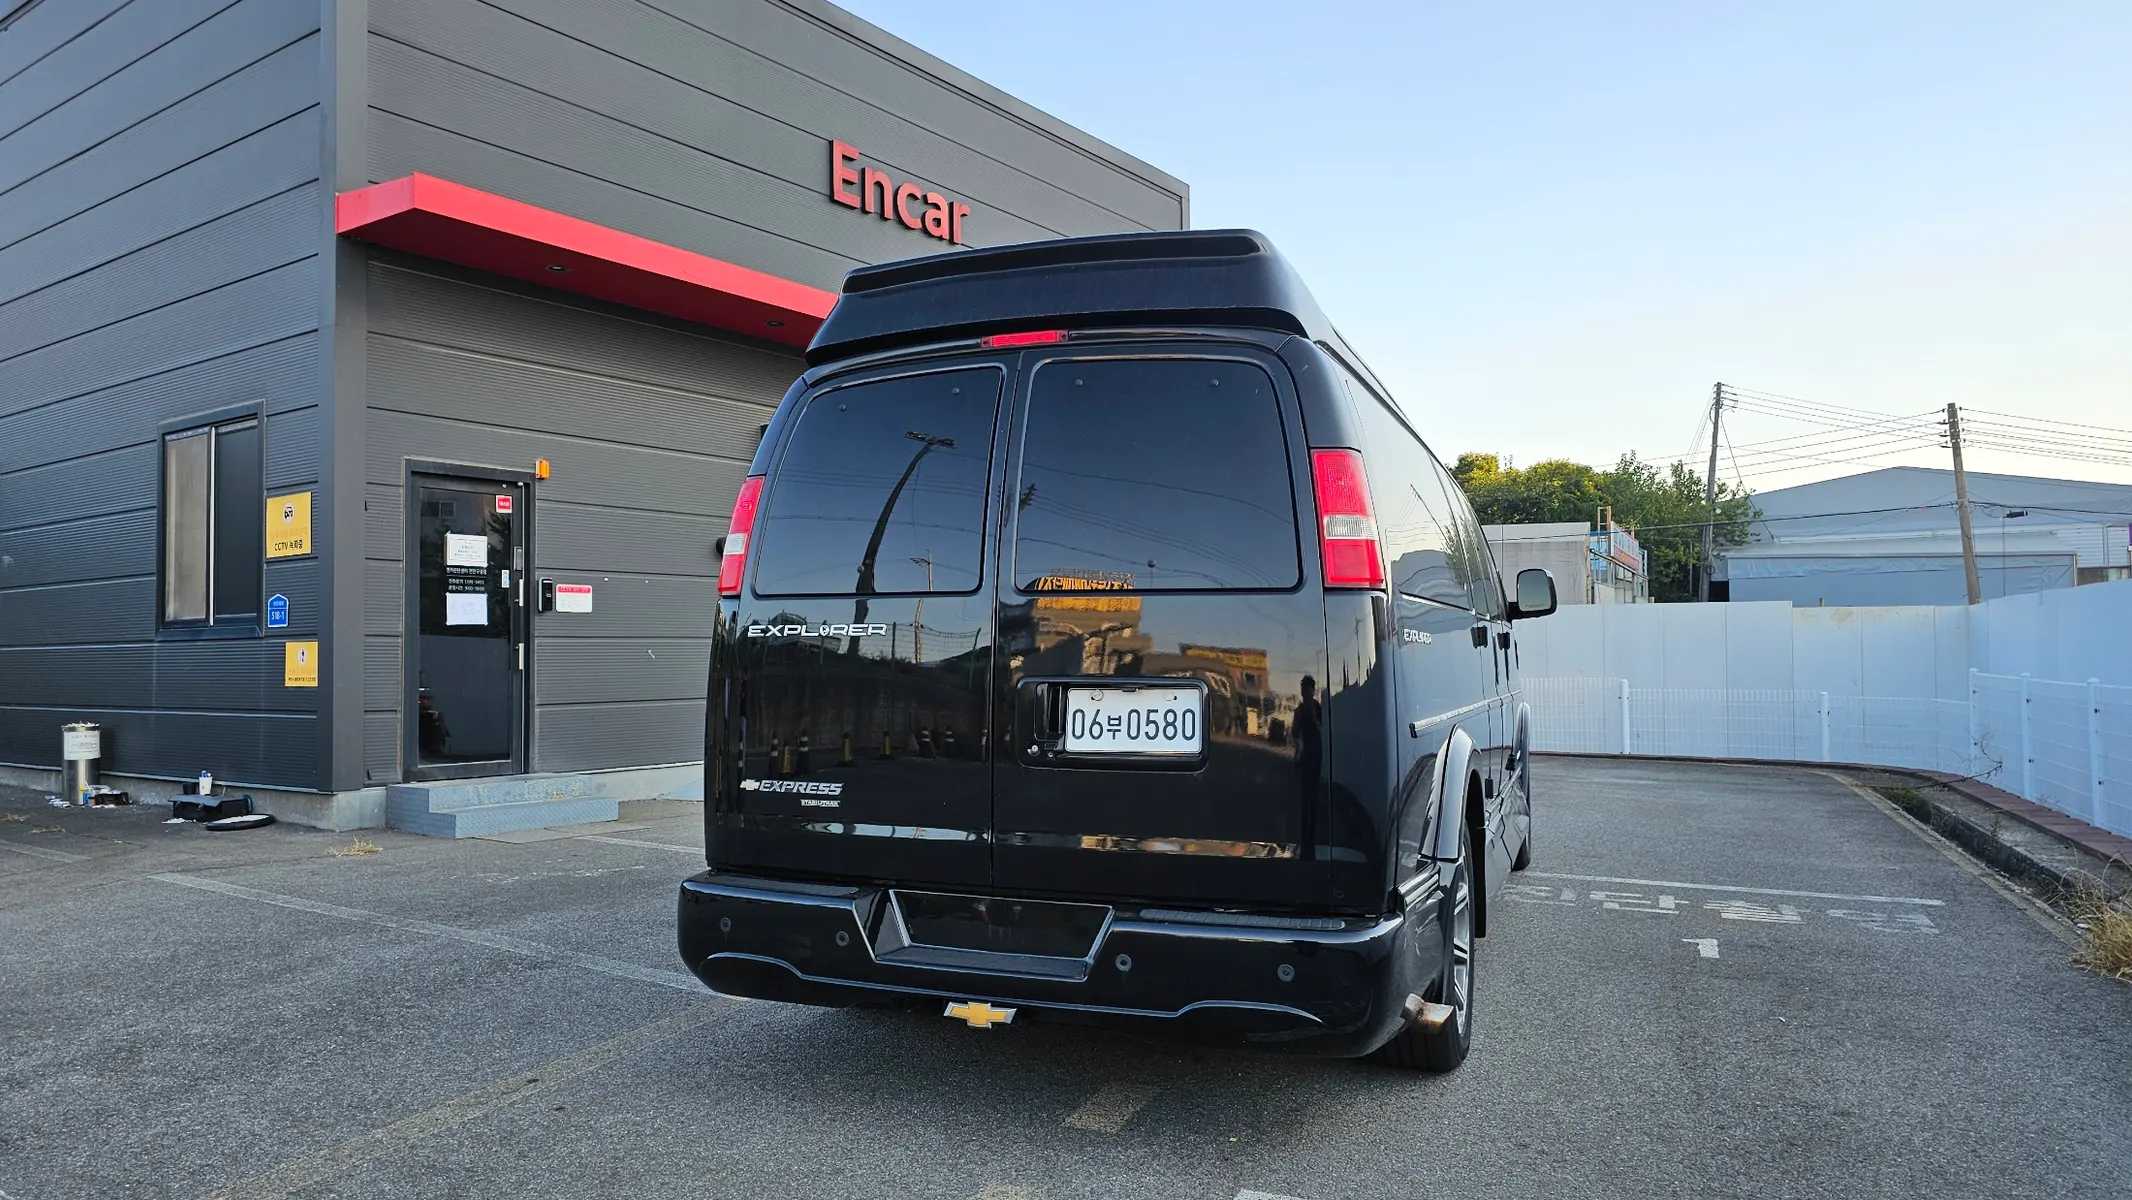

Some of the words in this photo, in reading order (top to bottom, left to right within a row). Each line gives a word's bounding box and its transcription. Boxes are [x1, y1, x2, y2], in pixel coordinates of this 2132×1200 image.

[831, 138, 971, 245] Encar
[274, 541, 289, 552] CCTV
[289, 538, 304, 550] 녹화중
[748, 623, 887, 638] EXPLORER
[1071, 708, 1196, 742] 06부0580
[758, 779, 845, 796] EXPRESS
[1680, 938, 1720, 959] 1
